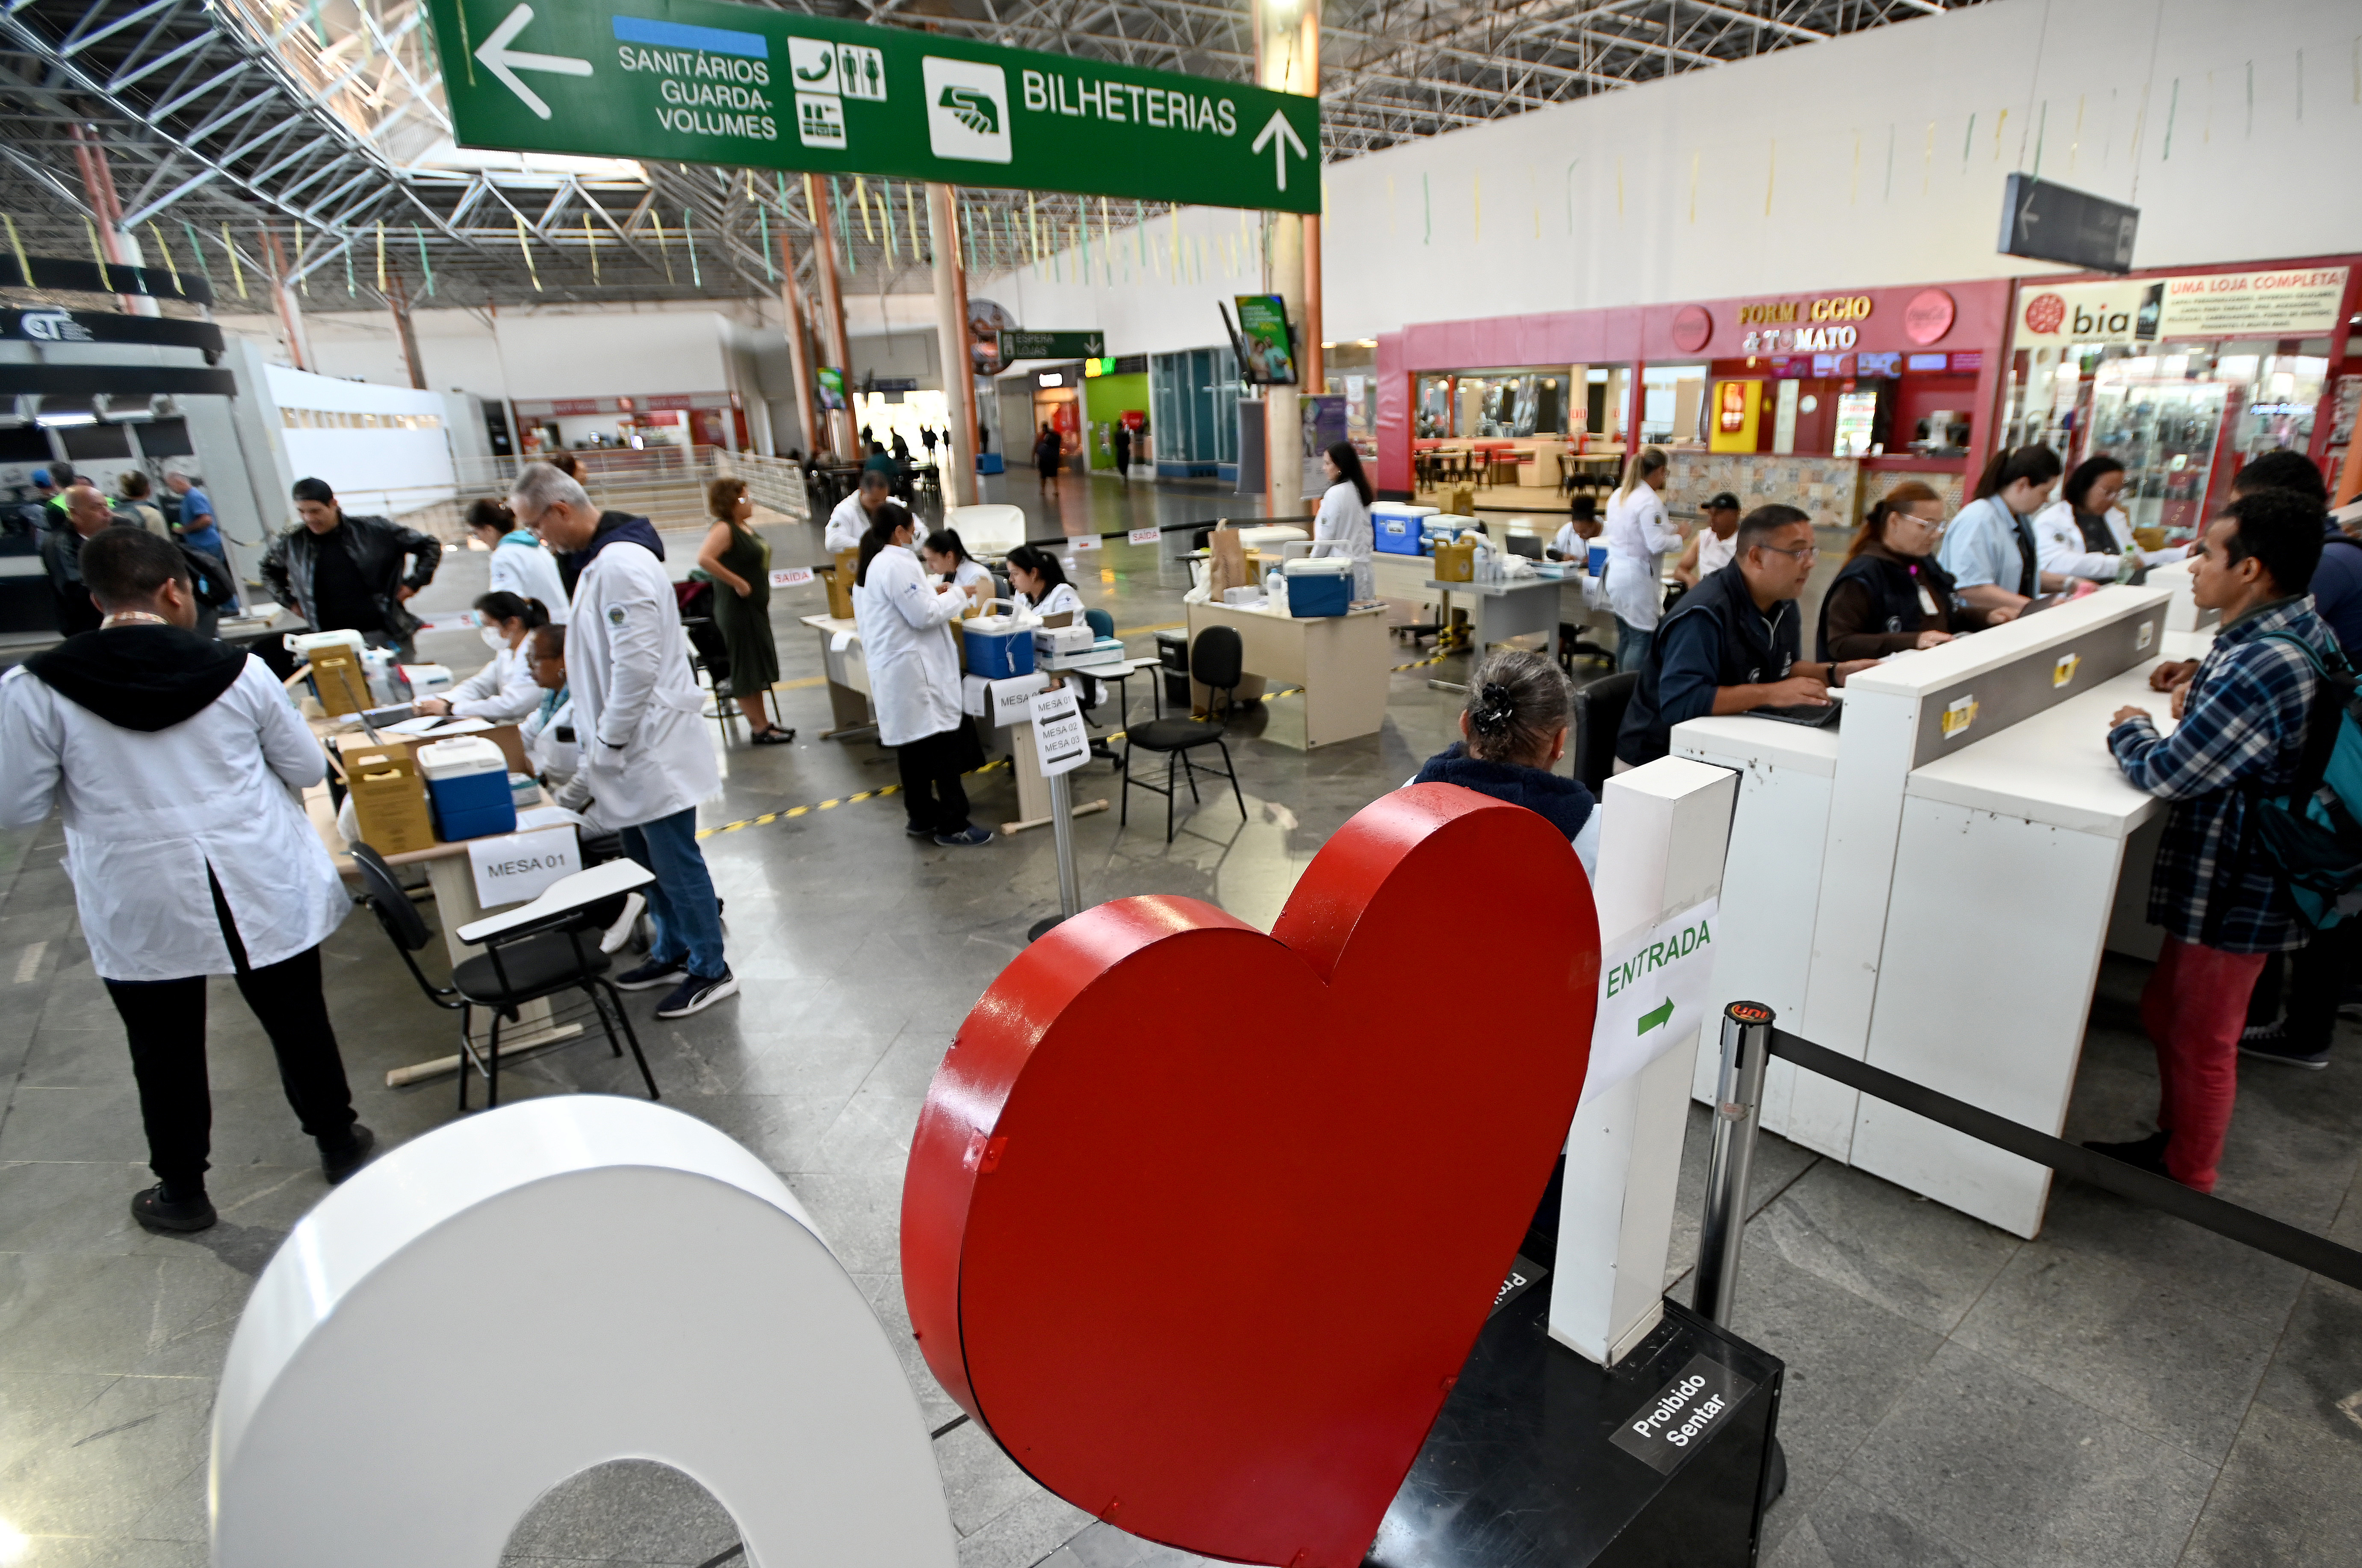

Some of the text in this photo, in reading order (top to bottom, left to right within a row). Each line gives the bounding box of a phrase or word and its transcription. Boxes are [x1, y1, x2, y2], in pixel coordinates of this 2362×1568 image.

[618, 45, 770, 86] SANITÁRIOS
[661, 79, 774, 112] GUARDA-
[1022, 69, 1237, 137] BILHETERIAS
[655, 107, 778, 141] VOLUMES
[2171, 281, 2205, 295] UMA
[2210, 277, 2248, 292] LOJA
[2073, 303, 2130, 333] bia
[1742, 325, 1857, 353] & TOMATO
[1001, 693, 1029, 707] MESA
[1038, 696, 1071, 712] MESA 01
[1042, 722, 1078, 739] MESA 02
[1045, 735, 1080, 753] MESA 03
[487, 854, 566, 878] MESA 01
[1606, 920, 1711, 999] ENTRADA
[1632, 1375, 1706, 1438] Proibido
[1666, 1393, 1726, 1447] Sentar
